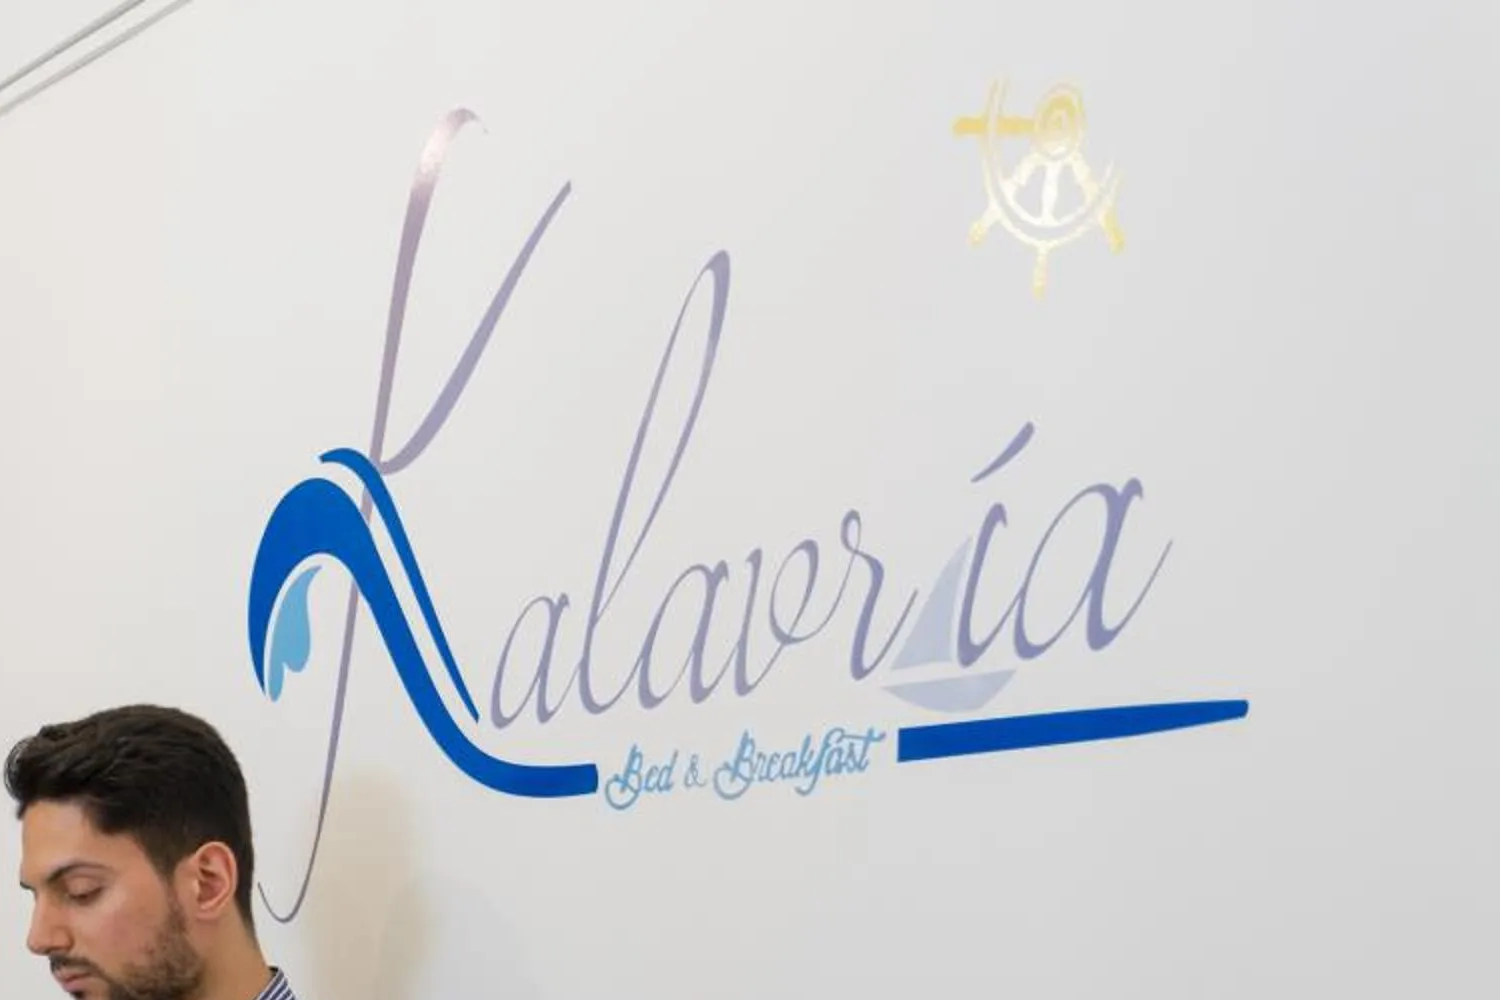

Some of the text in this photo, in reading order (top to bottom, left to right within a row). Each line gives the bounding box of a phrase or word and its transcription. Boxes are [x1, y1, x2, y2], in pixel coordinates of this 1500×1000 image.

[606, 727, 887, 811] Bed & Breakfast
